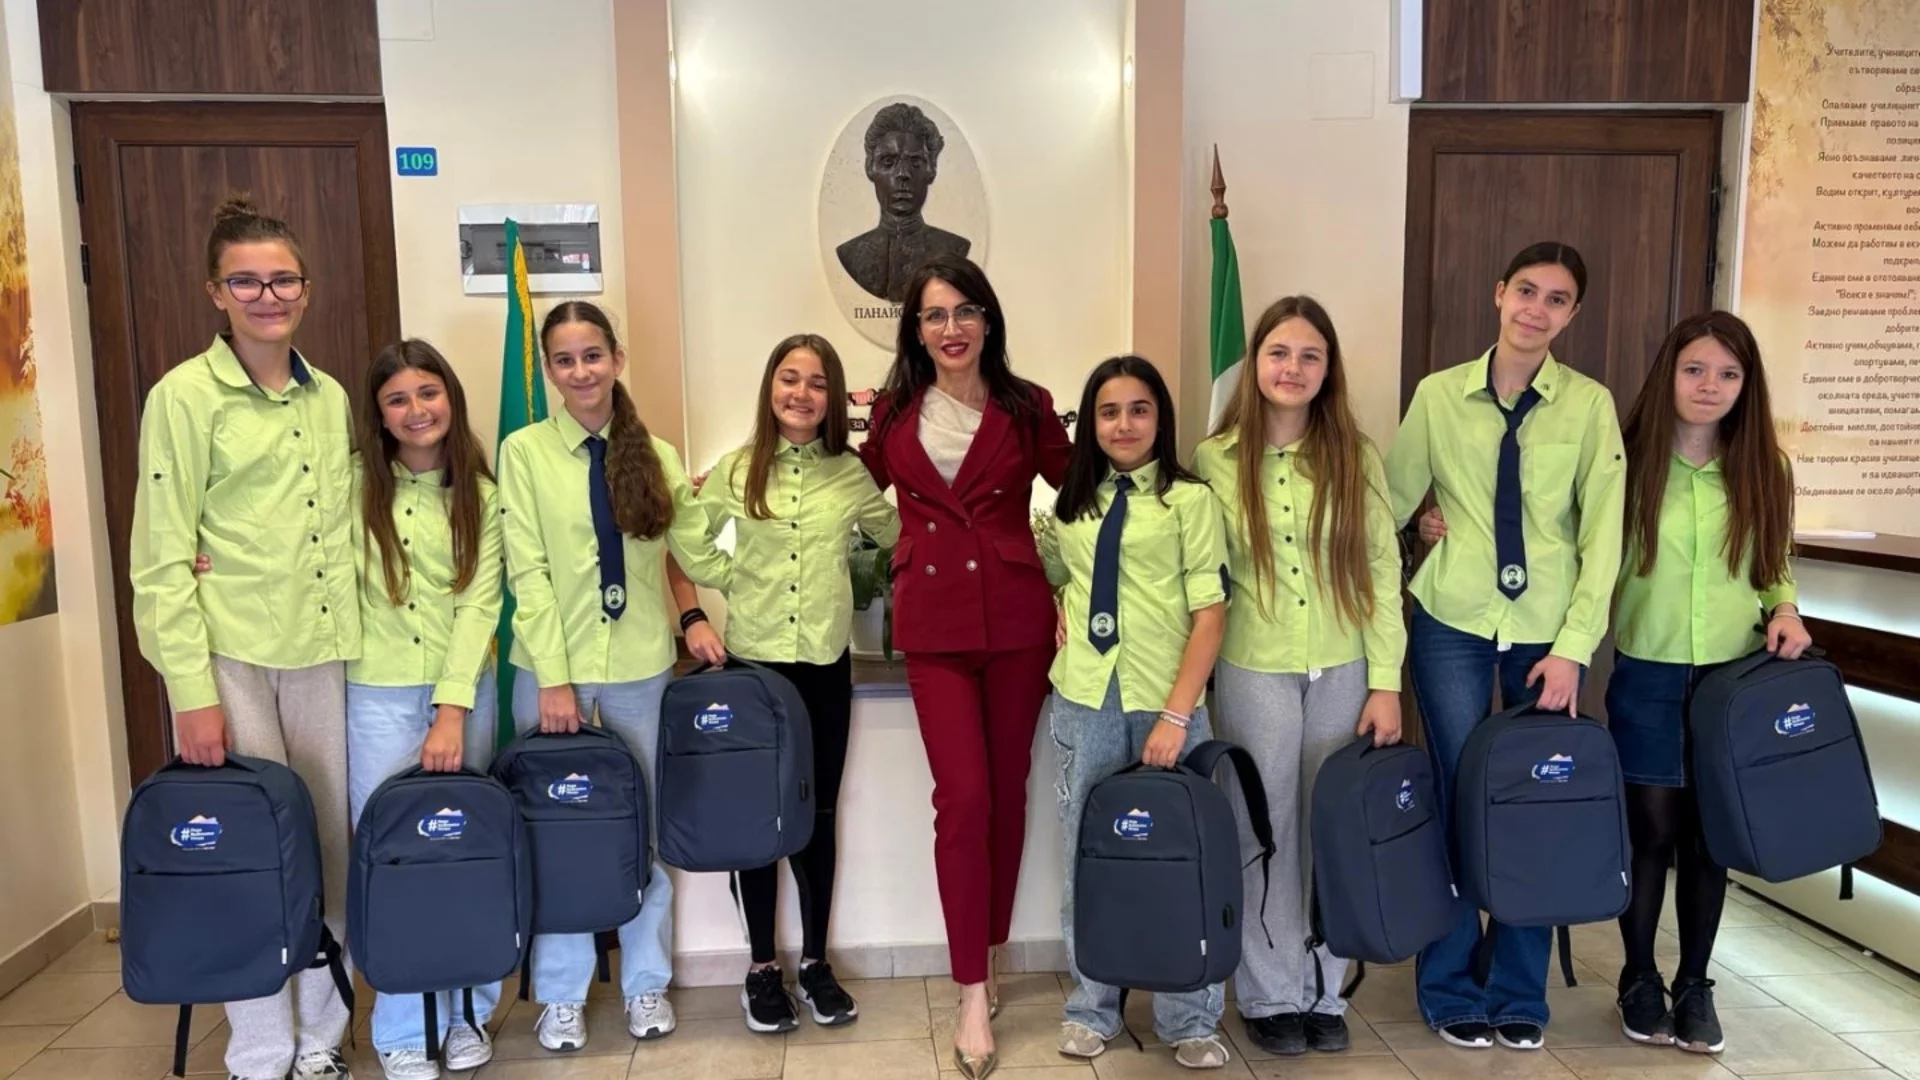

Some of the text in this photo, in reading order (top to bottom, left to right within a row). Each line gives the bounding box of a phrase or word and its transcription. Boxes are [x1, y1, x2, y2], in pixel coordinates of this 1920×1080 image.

[1820, 116, 1919, 130] Приемаме правото на
[399, 152, 434, 170] 109
[1818, 152, 1840, 162] Ясно
[1852, 172, 1902, 180] качеството
[1816, 186, 1846, 196] Водим
[1848, 189, 1880, 199] открит,
[1814, 220, 1852, 231] Активно
[1854, 223, 1902, 234] променяме
[1812, 238, 1846, 248] Можем
[1847, 240, 1858, 249] да
[1860, 238, 1897, 251] работим
[1808, 306, 1841, 316] Заедно
[1842, 308, 1886, 318] решаваме
[1805, 340, 1844, 350] Активно
[1854, 359, 1907, 369] спортуваме,
[1818, 392, 1860, 400] околната
[1862, 392, 1889, 402] среда,
[1817, 456, 1848, 466] творим
